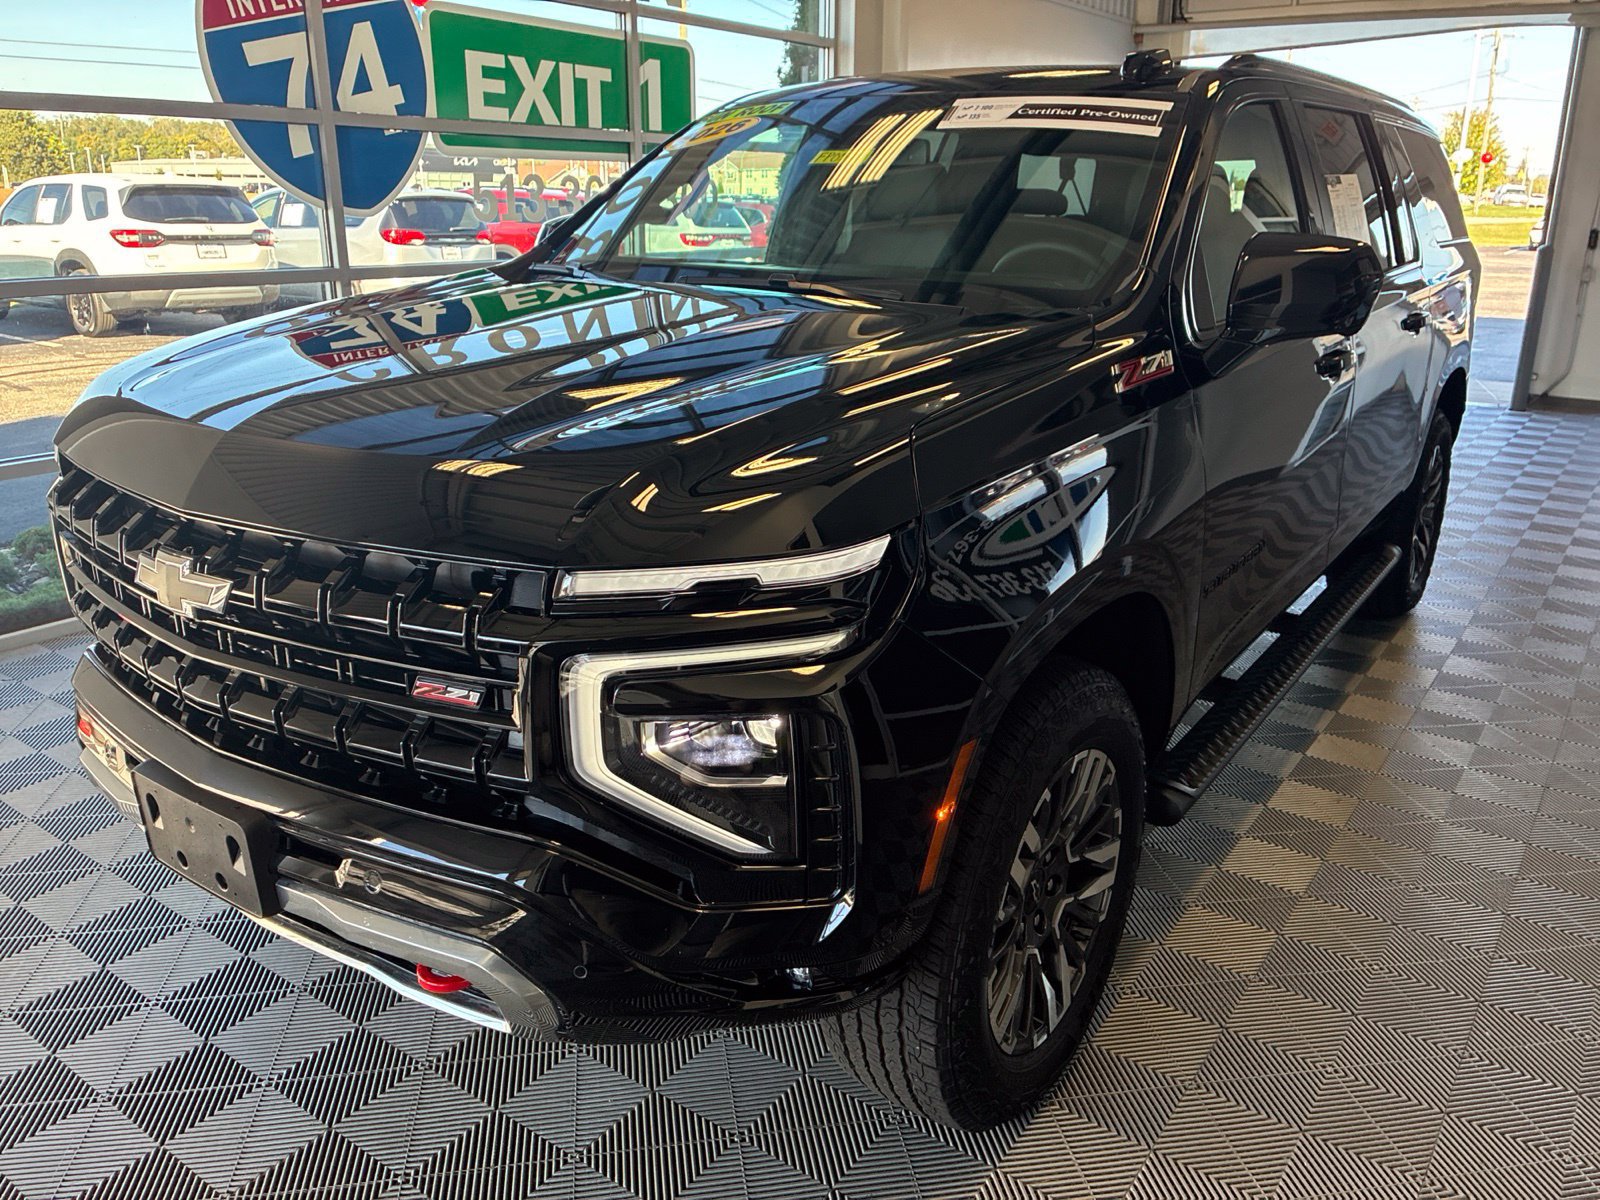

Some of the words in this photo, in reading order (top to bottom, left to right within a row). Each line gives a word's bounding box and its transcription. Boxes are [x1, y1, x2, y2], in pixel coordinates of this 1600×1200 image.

[242, 20, 405, 158] 74
[464, 49, 612, 129] EXIT
[1017, 107, 1077, 116] Certified
[1080, 105, 1158, 122] Pre-Owned
[1111, 349, 1174, 393] Z71
[412, 681, 481, 707] Z71
